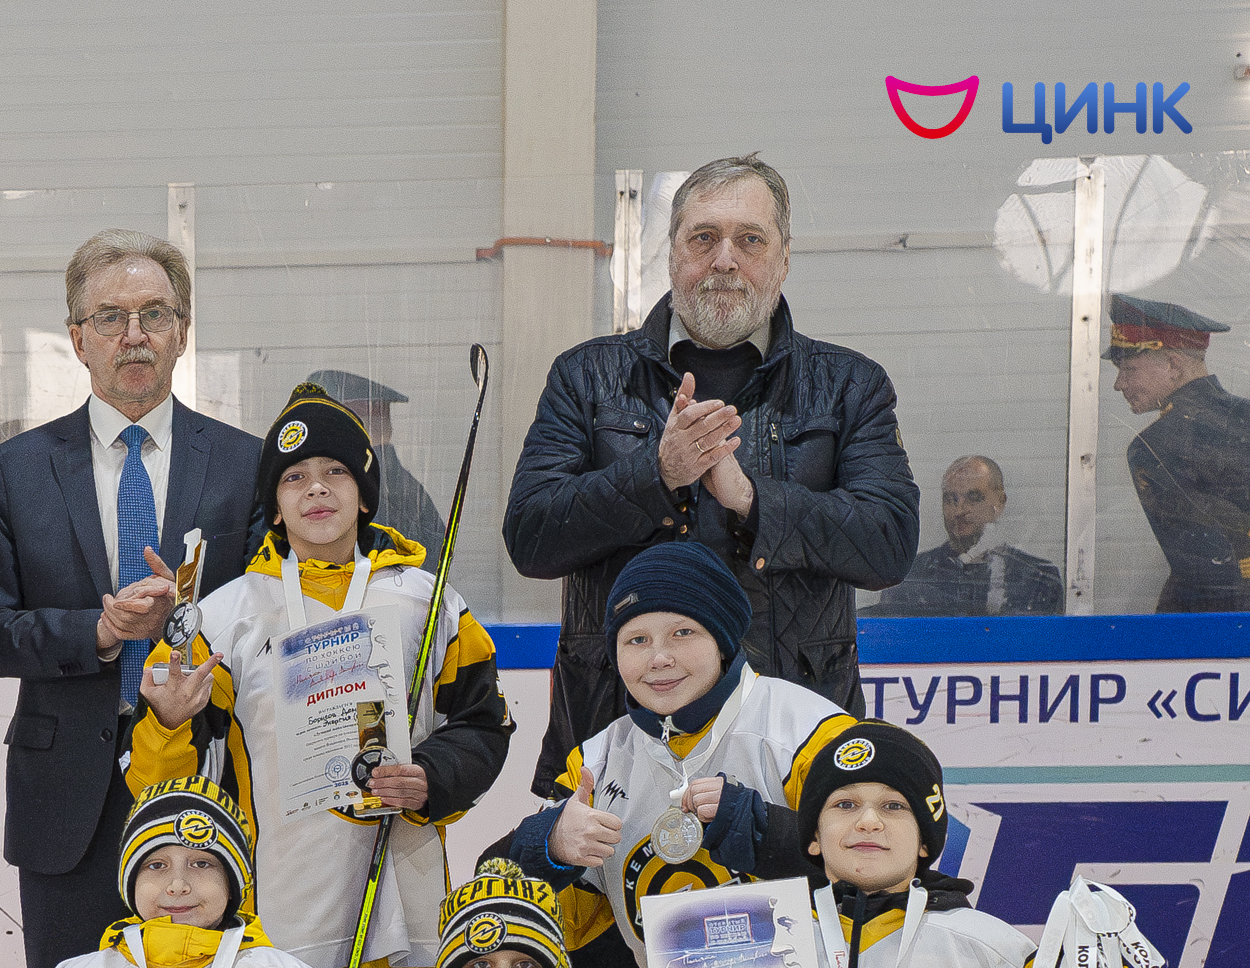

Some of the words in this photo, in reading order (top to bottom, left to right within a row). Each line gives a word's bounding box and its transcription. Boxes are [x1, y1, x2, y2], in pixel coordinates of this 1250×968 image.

[306, 632, 360, 654] ТУРНИР
[306, 680, 366, 706] ДИПЛОМ
[861, 673, 1126, 724] ТУРНИР
